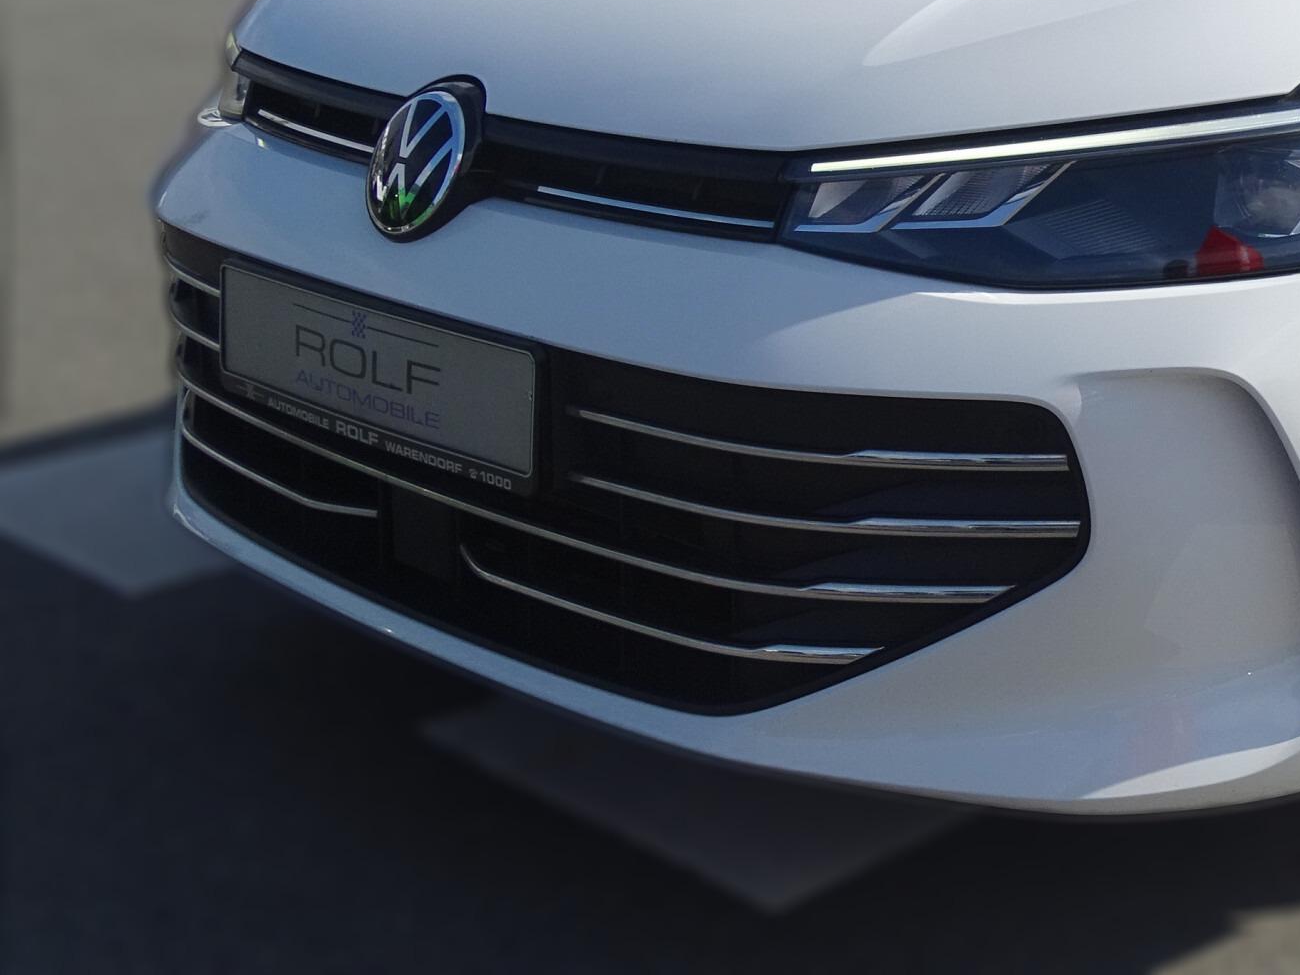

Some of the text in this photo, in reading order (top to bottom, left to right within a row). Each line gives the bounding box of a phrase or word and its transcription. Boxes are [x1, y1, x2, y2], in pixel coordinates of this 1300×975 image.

[295, 324, 441, 395] ROLF
[295, 370, 441, 429] AUTOMOBILE
[267, 396, 329, 430] AUTOMOBILE
[336, 419, 379, 446] ROLF
[385, 440, 463, 475] WARENDORF
